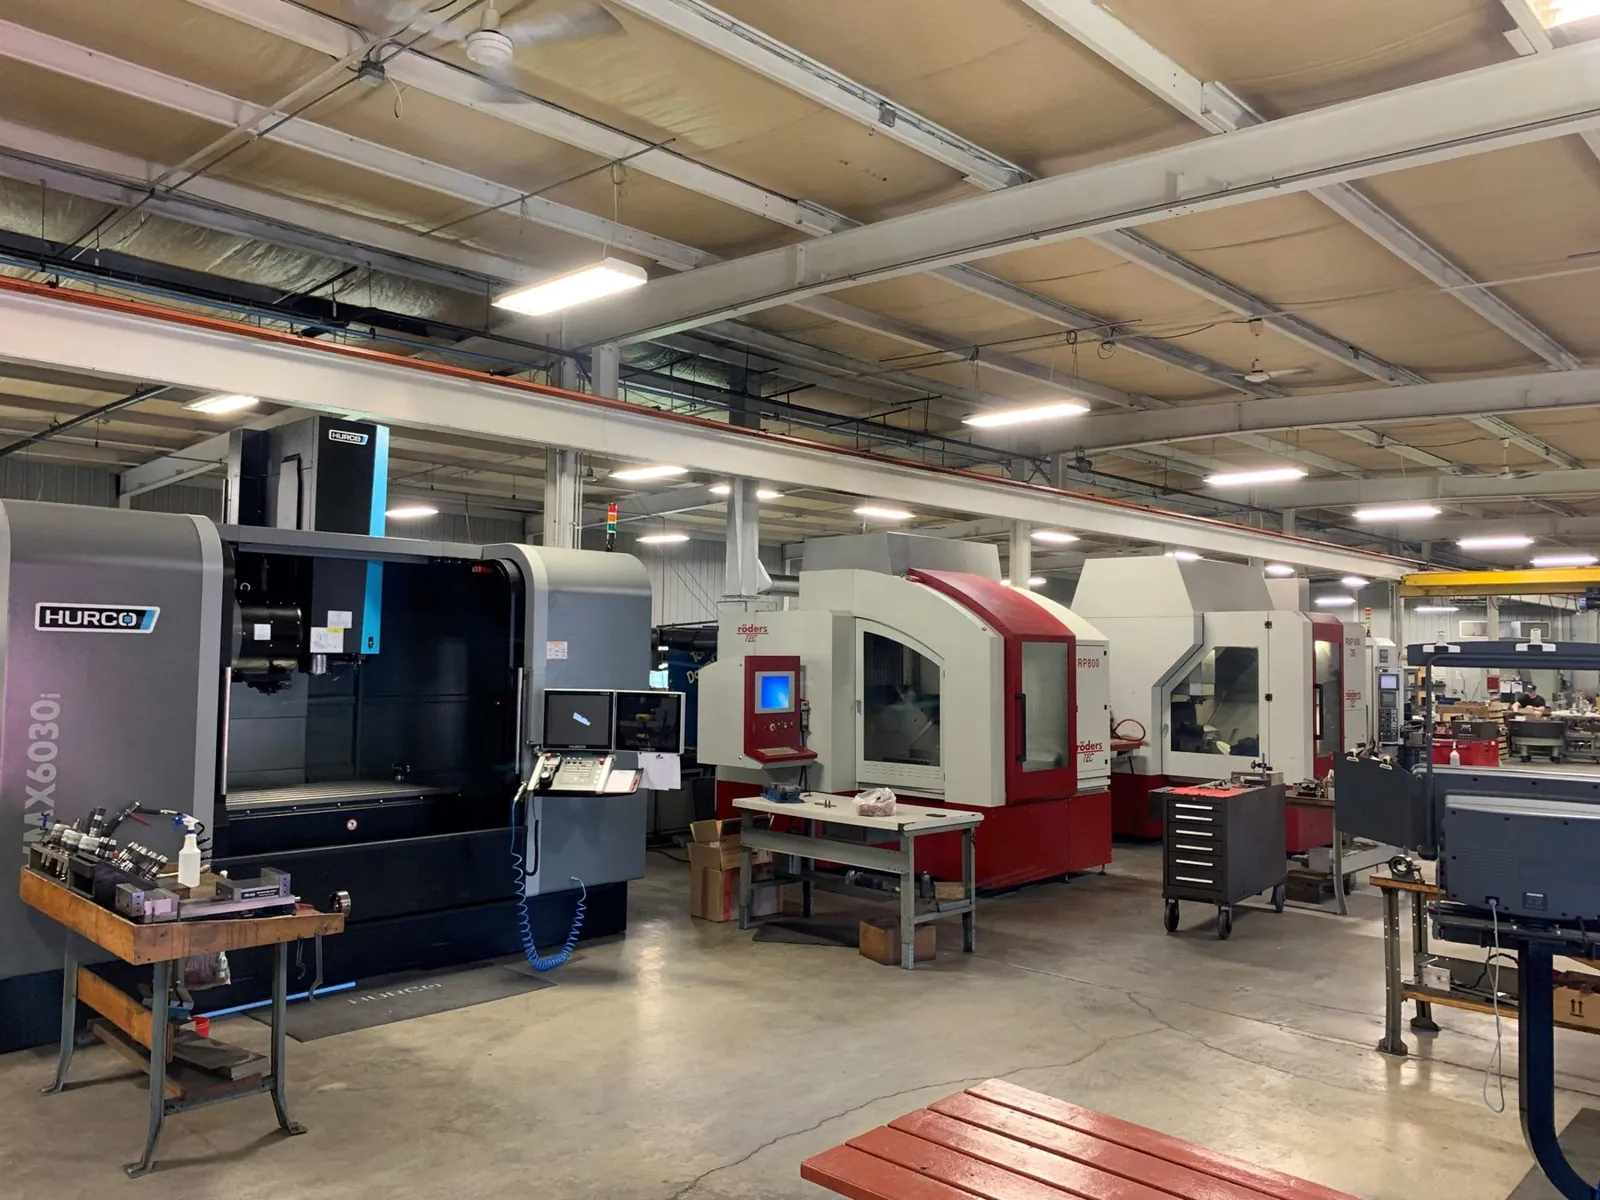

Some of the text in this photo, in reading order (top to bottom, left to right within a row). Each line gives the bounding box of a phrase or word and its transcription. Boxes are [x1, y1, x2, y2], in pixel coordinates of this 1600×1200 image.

[332, 432, 362, 442] HURCO
[45, 609, 137, 627] HURCO
[737, 623, 768, 633] röders
[1077, 658, 1100, 668] RP800
[1076, 739, 1103, 751] röders
